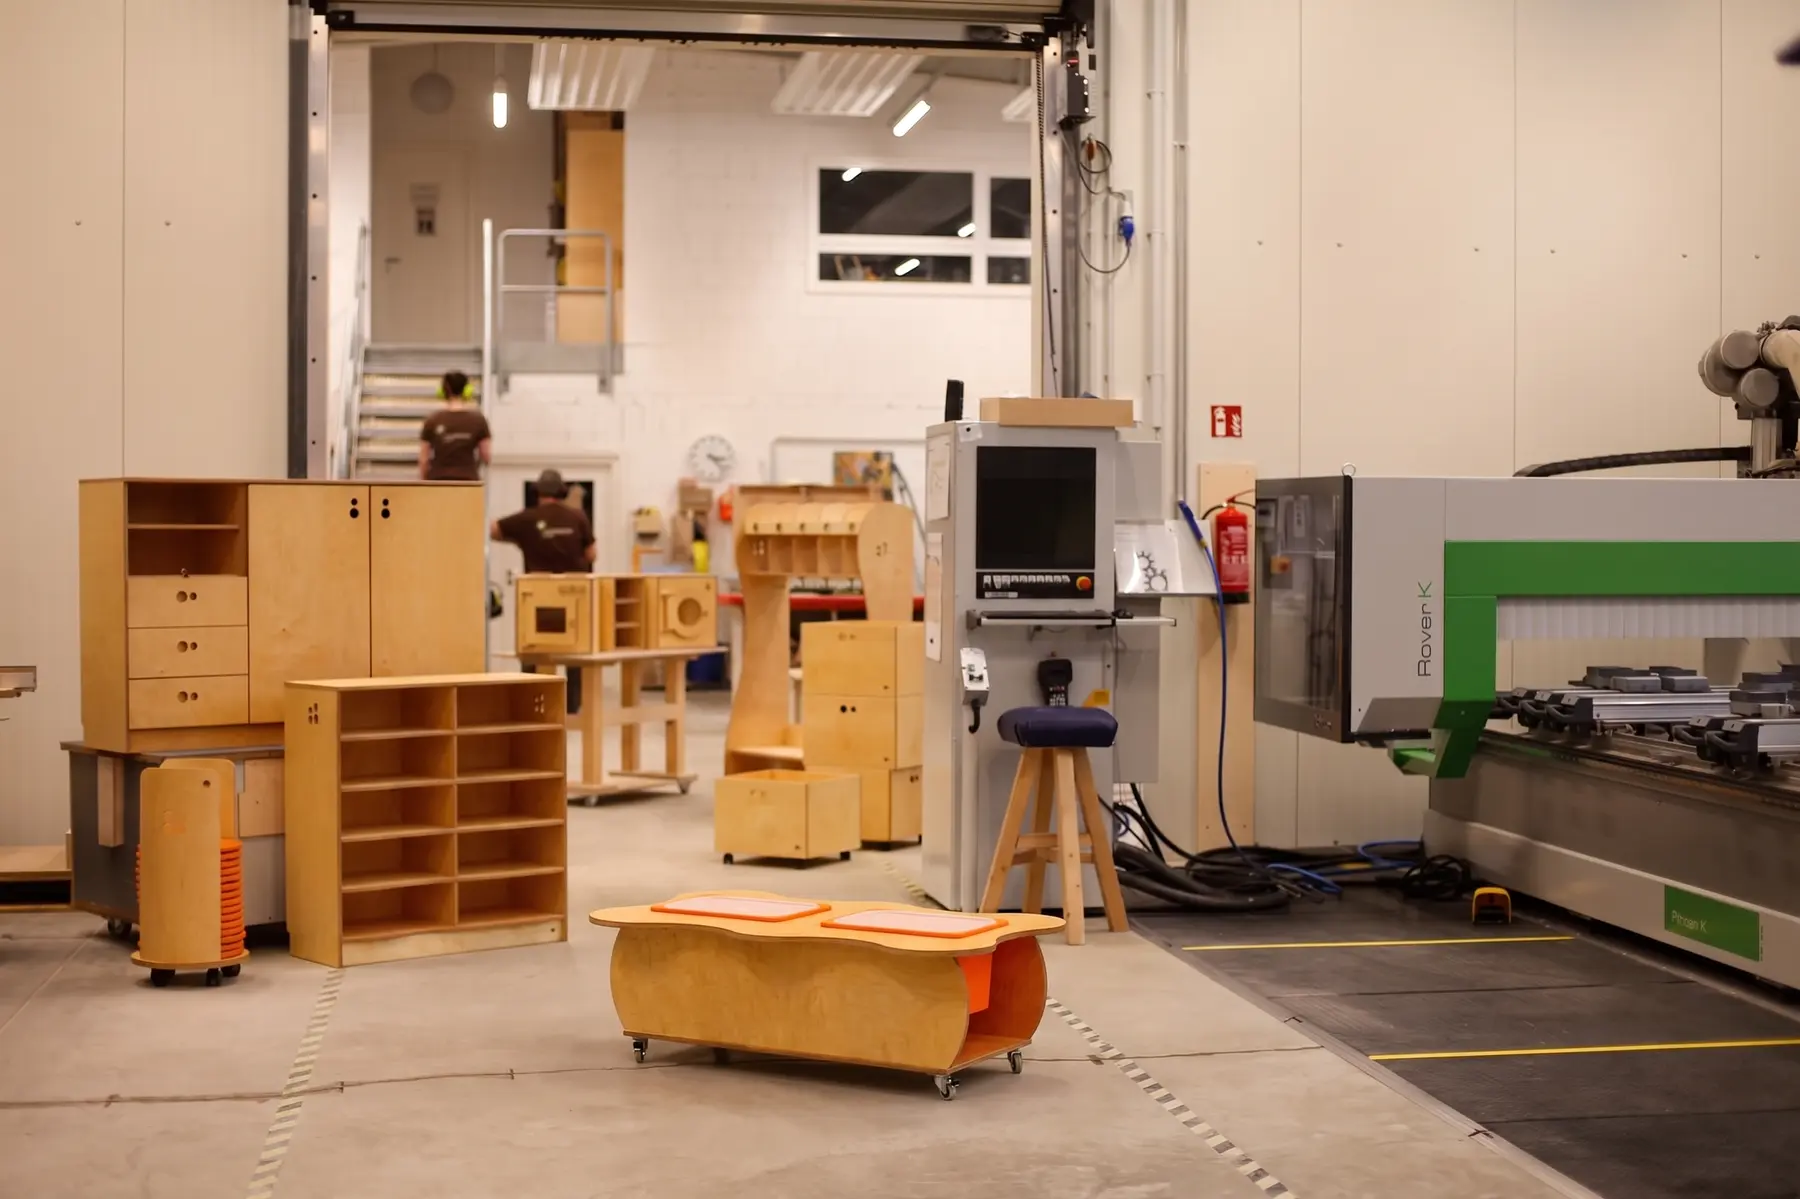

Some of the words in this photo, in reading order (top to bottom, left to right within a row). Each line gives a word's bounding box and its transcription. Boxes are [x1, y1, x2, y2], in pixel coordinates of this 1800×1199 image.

[1417, 581, 1432, 598] K
[1417, 603, 1432, 677] Rover
[1700, 919, 1708, 934] K
